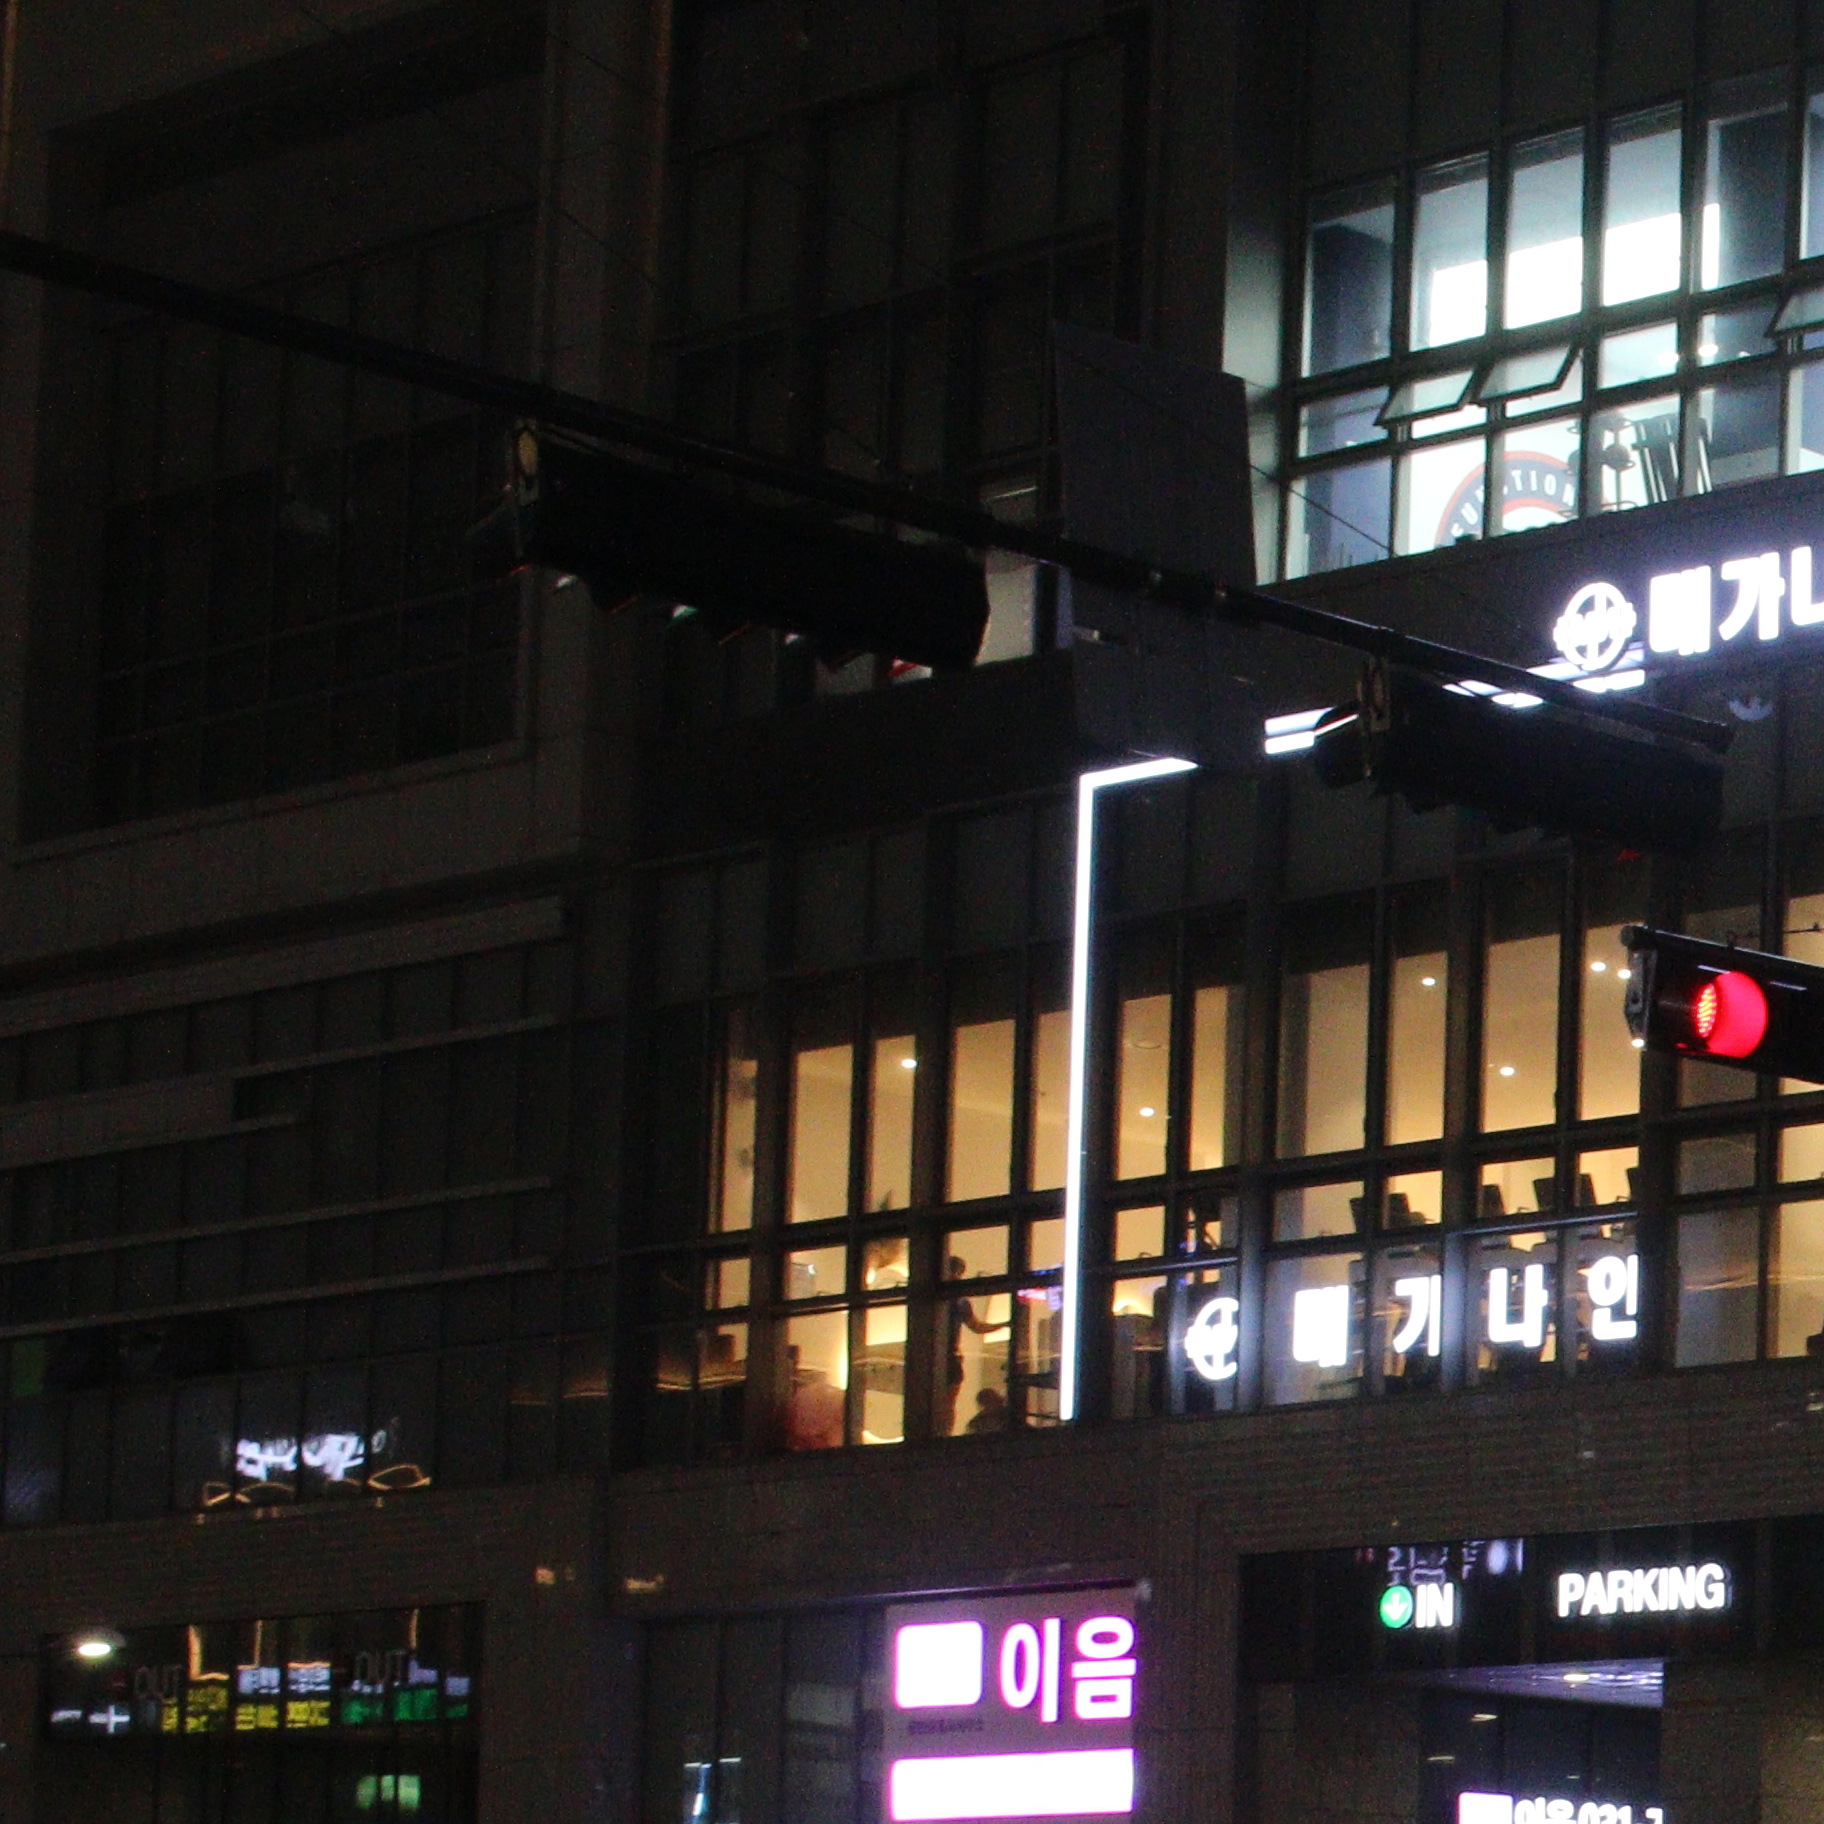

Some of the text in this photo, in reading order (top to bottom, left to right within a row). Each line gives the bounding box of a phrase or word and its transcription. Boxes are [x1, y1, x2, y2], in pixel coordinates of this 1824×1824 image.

[1414, 1581, 1455, 1629] IN
[1556, 1562, 1726, 1618] PARKING
[1000, 1616, 1137, 1723] 이음
